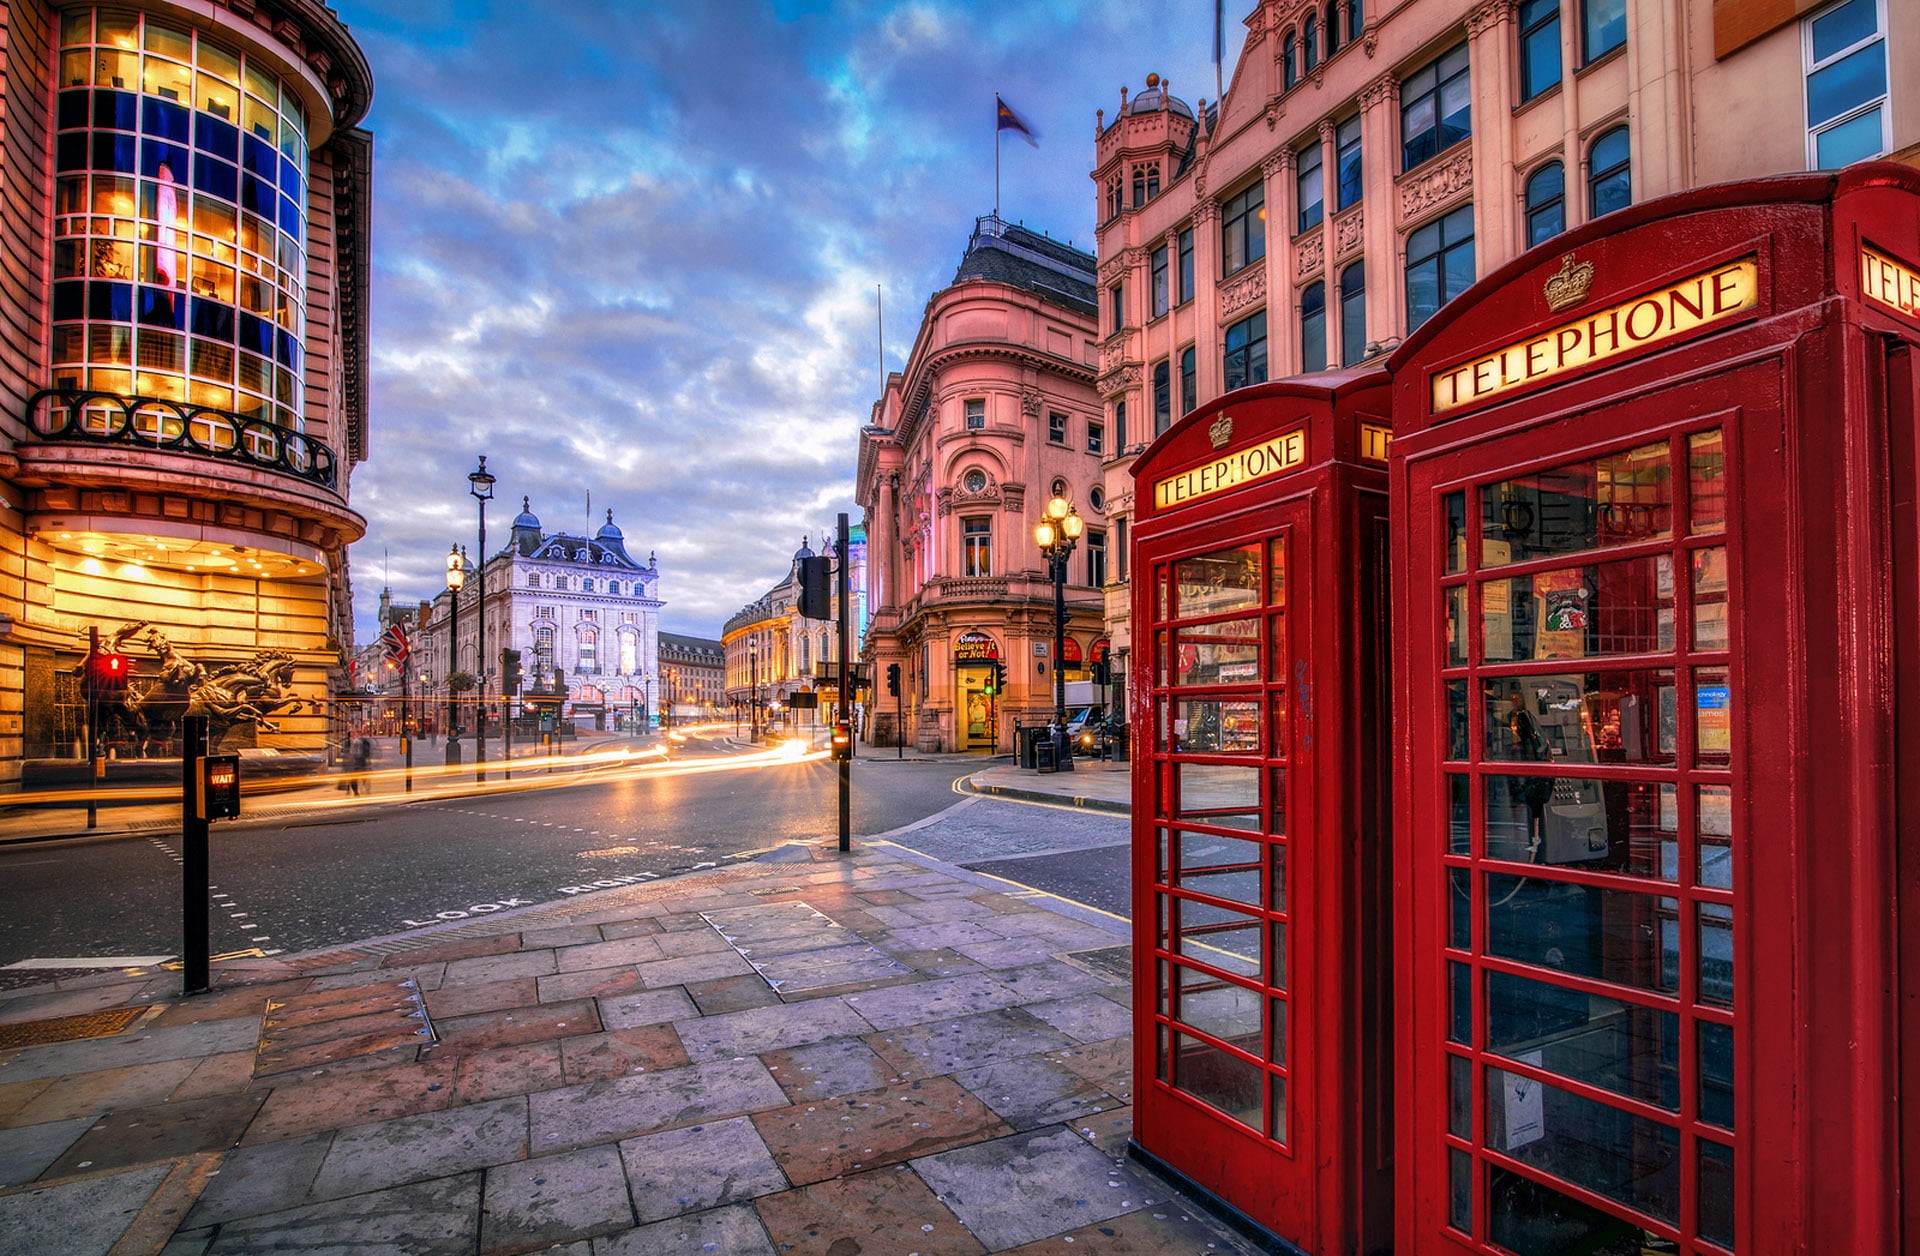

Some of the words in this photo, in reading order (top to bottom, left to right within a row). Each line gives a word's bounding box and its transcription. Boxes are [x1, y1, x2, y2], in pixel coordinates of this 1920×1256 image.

[1441, 265, 1744, 405] TELEPHONE
[1160, 434, 1299, 505] TELEPHONE
[954, 642, 984, 651] Believe
[958, 651, 969, 659] or
[211, 774, 234, 785] WAIT
[402, 898, 534, 927] LOOK
[558, 871, 661, 896] RIGHT
